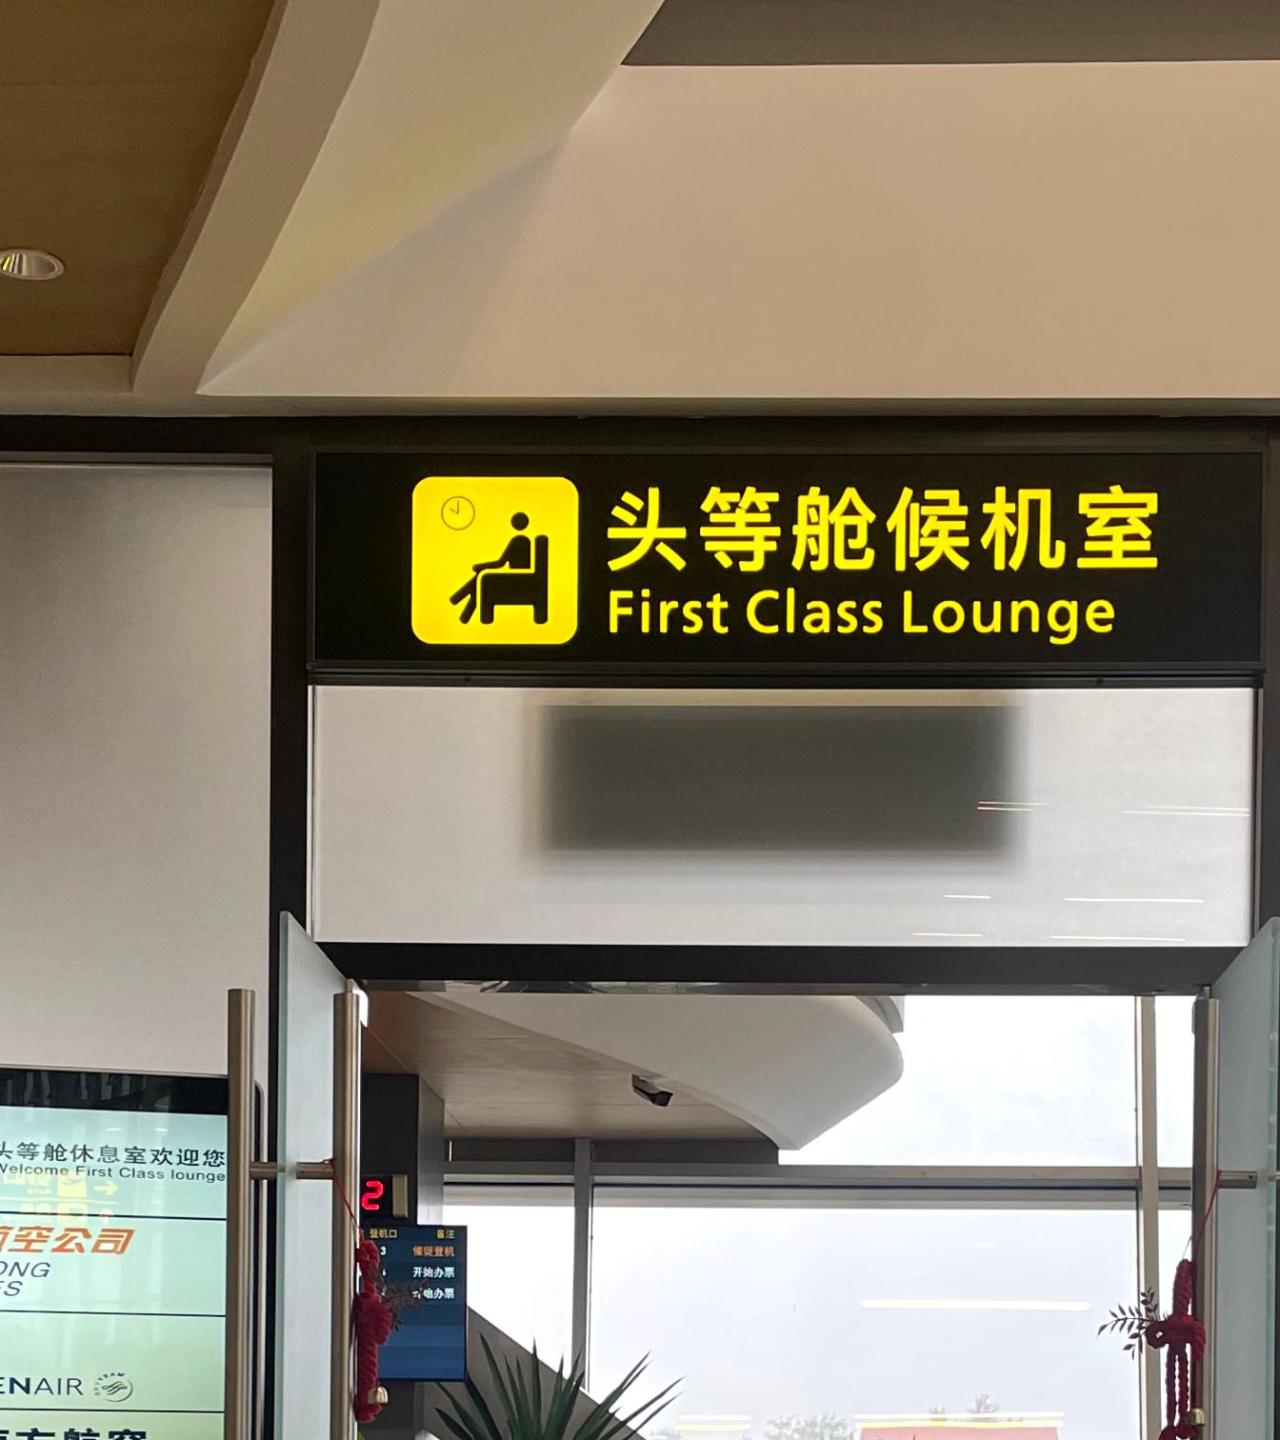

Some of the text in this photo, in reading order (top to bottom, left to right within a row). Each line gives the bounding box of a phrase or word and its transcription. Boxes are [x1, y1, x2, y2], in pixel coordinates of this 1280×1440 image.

[607, 485, 1159, 572] 头等舱候机室
[609, 588, 1115, 644] First Class Lounge
[75, 1165, 113, 1178] First
[119, 1167, 164, 1180] Class
[171, 1169, 226, 1183] lounge
[361, 1180, 384, 1211] 2
[413, 1267, 455, 1278] 开始办票
